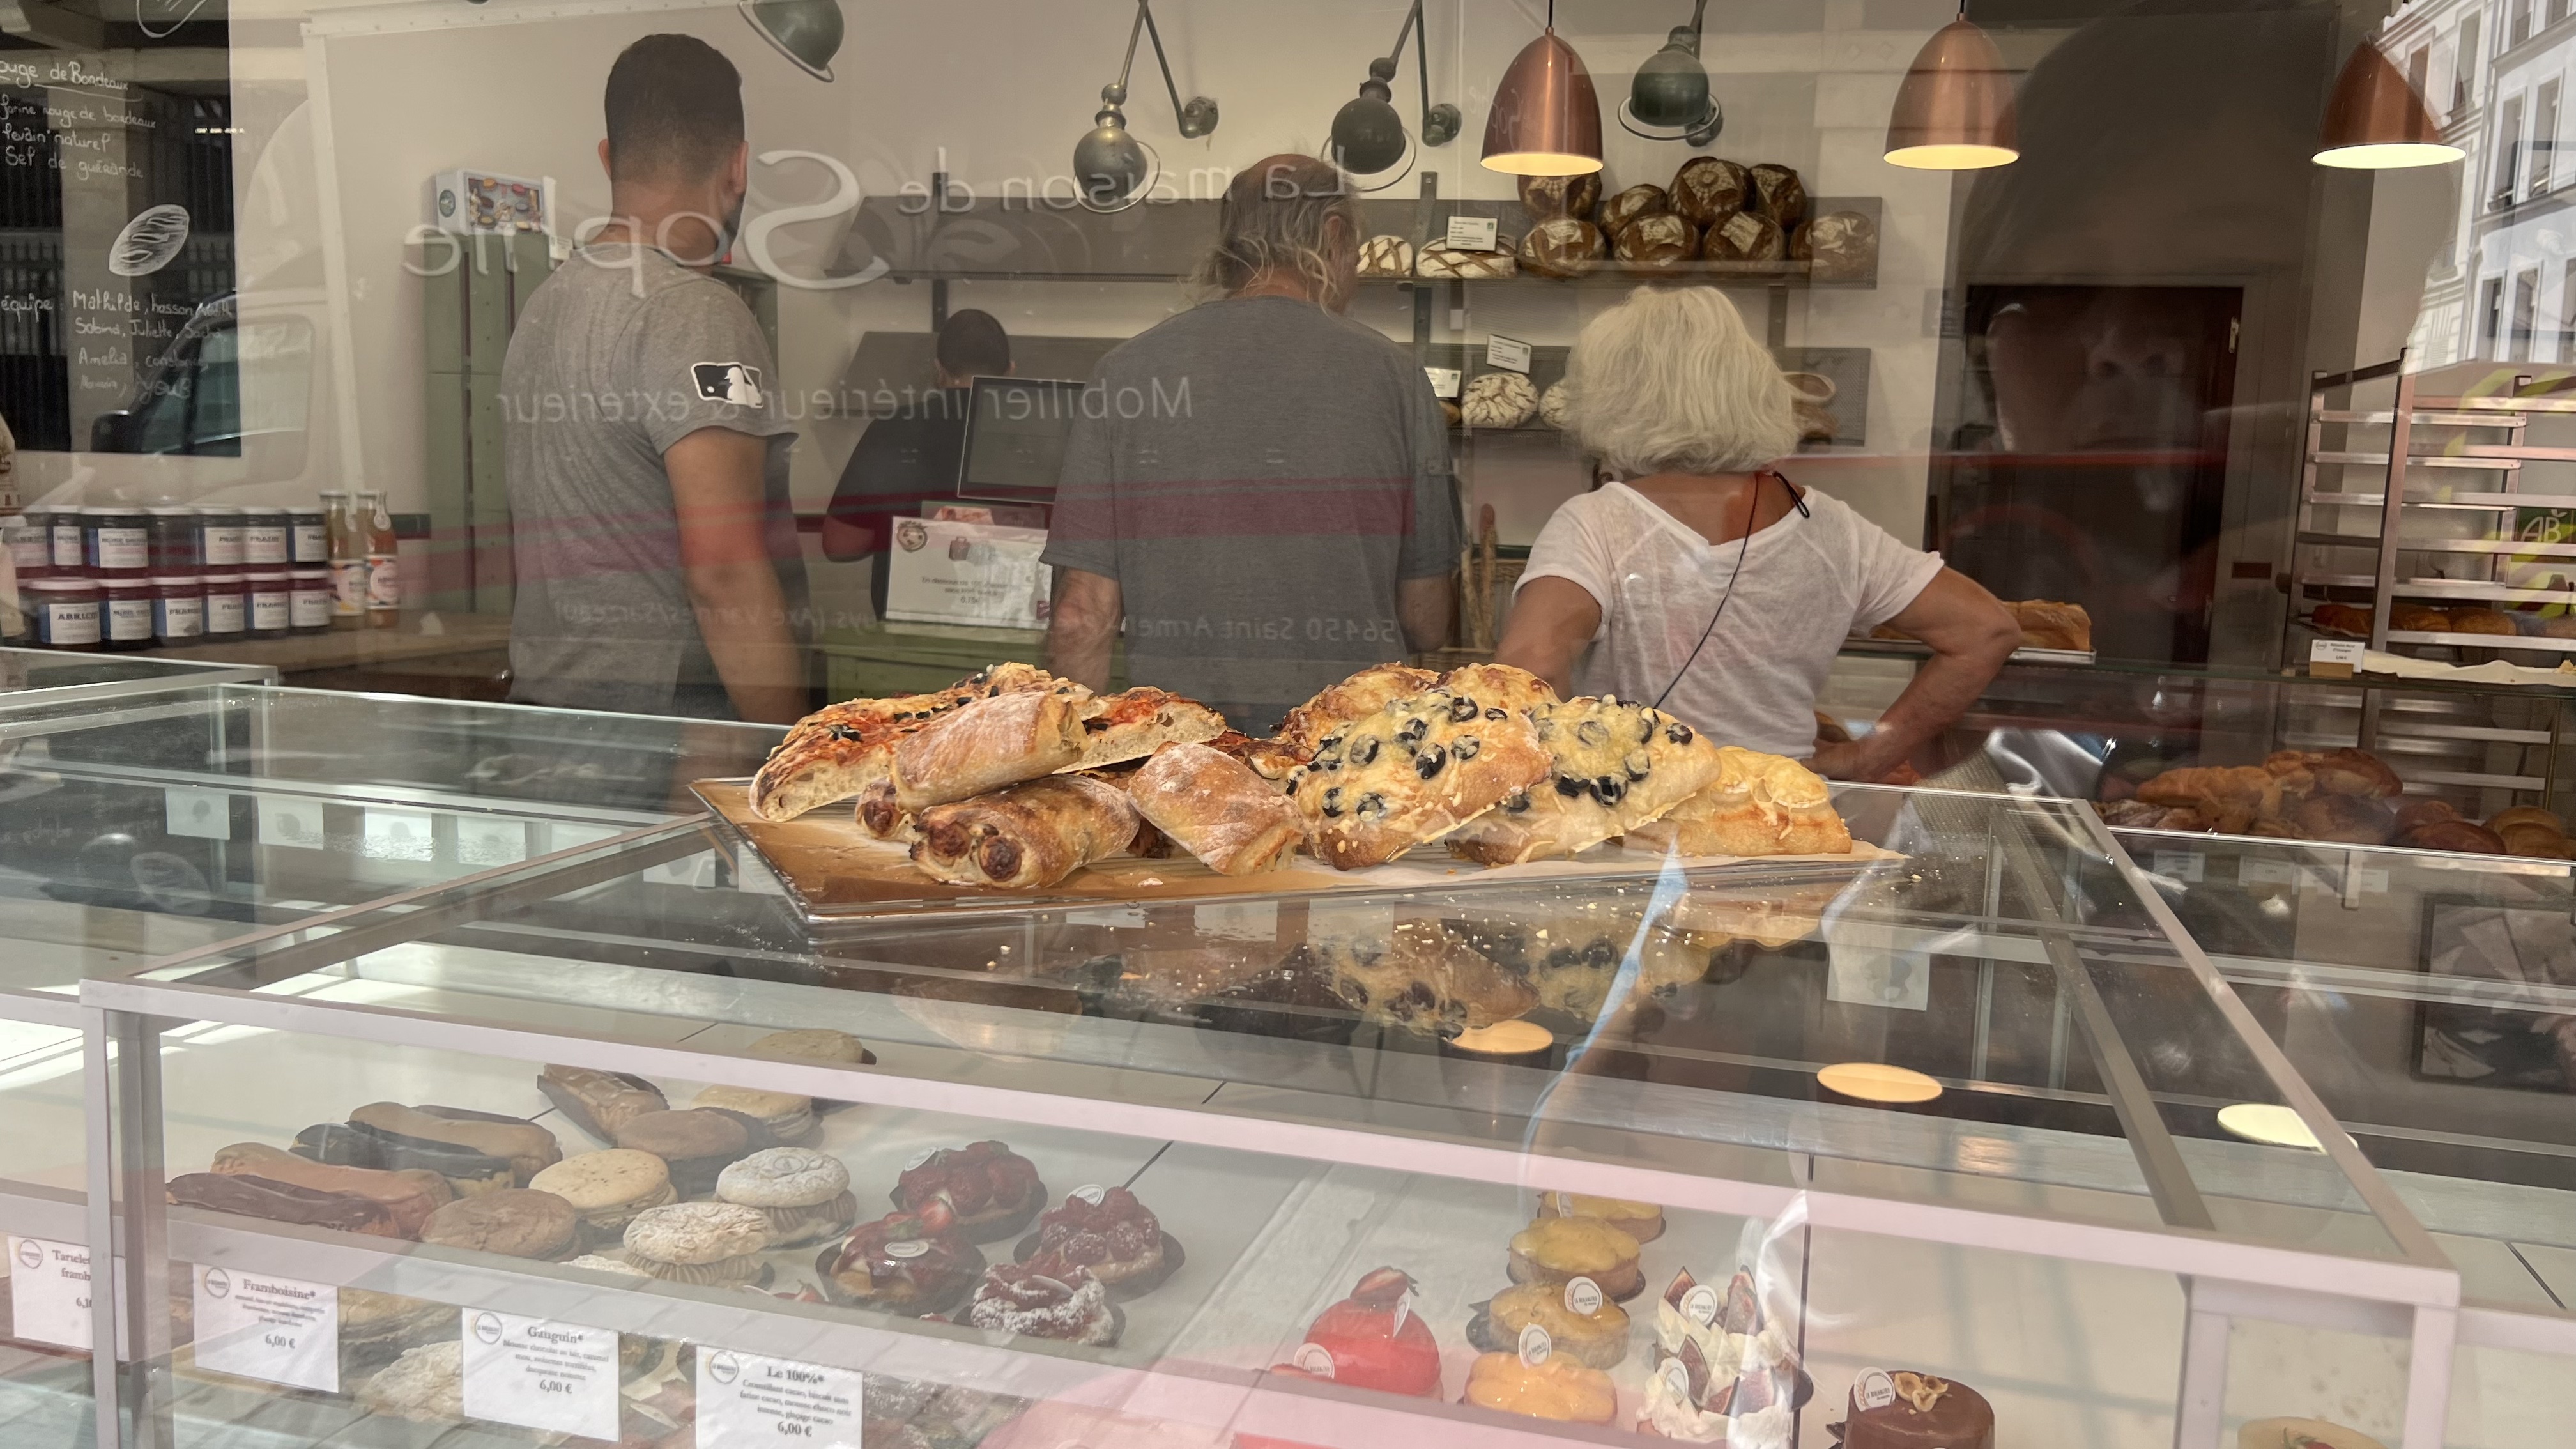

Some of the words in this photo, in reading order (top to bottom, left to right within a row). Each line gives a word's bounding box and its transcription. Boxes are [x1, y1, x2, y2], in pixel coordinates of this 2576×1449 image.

[50, 63, 68, 80] de
[79, 106, 96, 121] de
[48, 152, 67, 169] de
[265, 1333, 286, 1347] 6,00
[289, 1338, 296, 1349] €
[767, 1365, 783, 1379] Le
[539, 1379, 562, 1393] 6,00
[565, 1383, 572, 1394] €
[777, 1420, 802, 1436] 6,00
[804, 1425, 812, 1438] €
